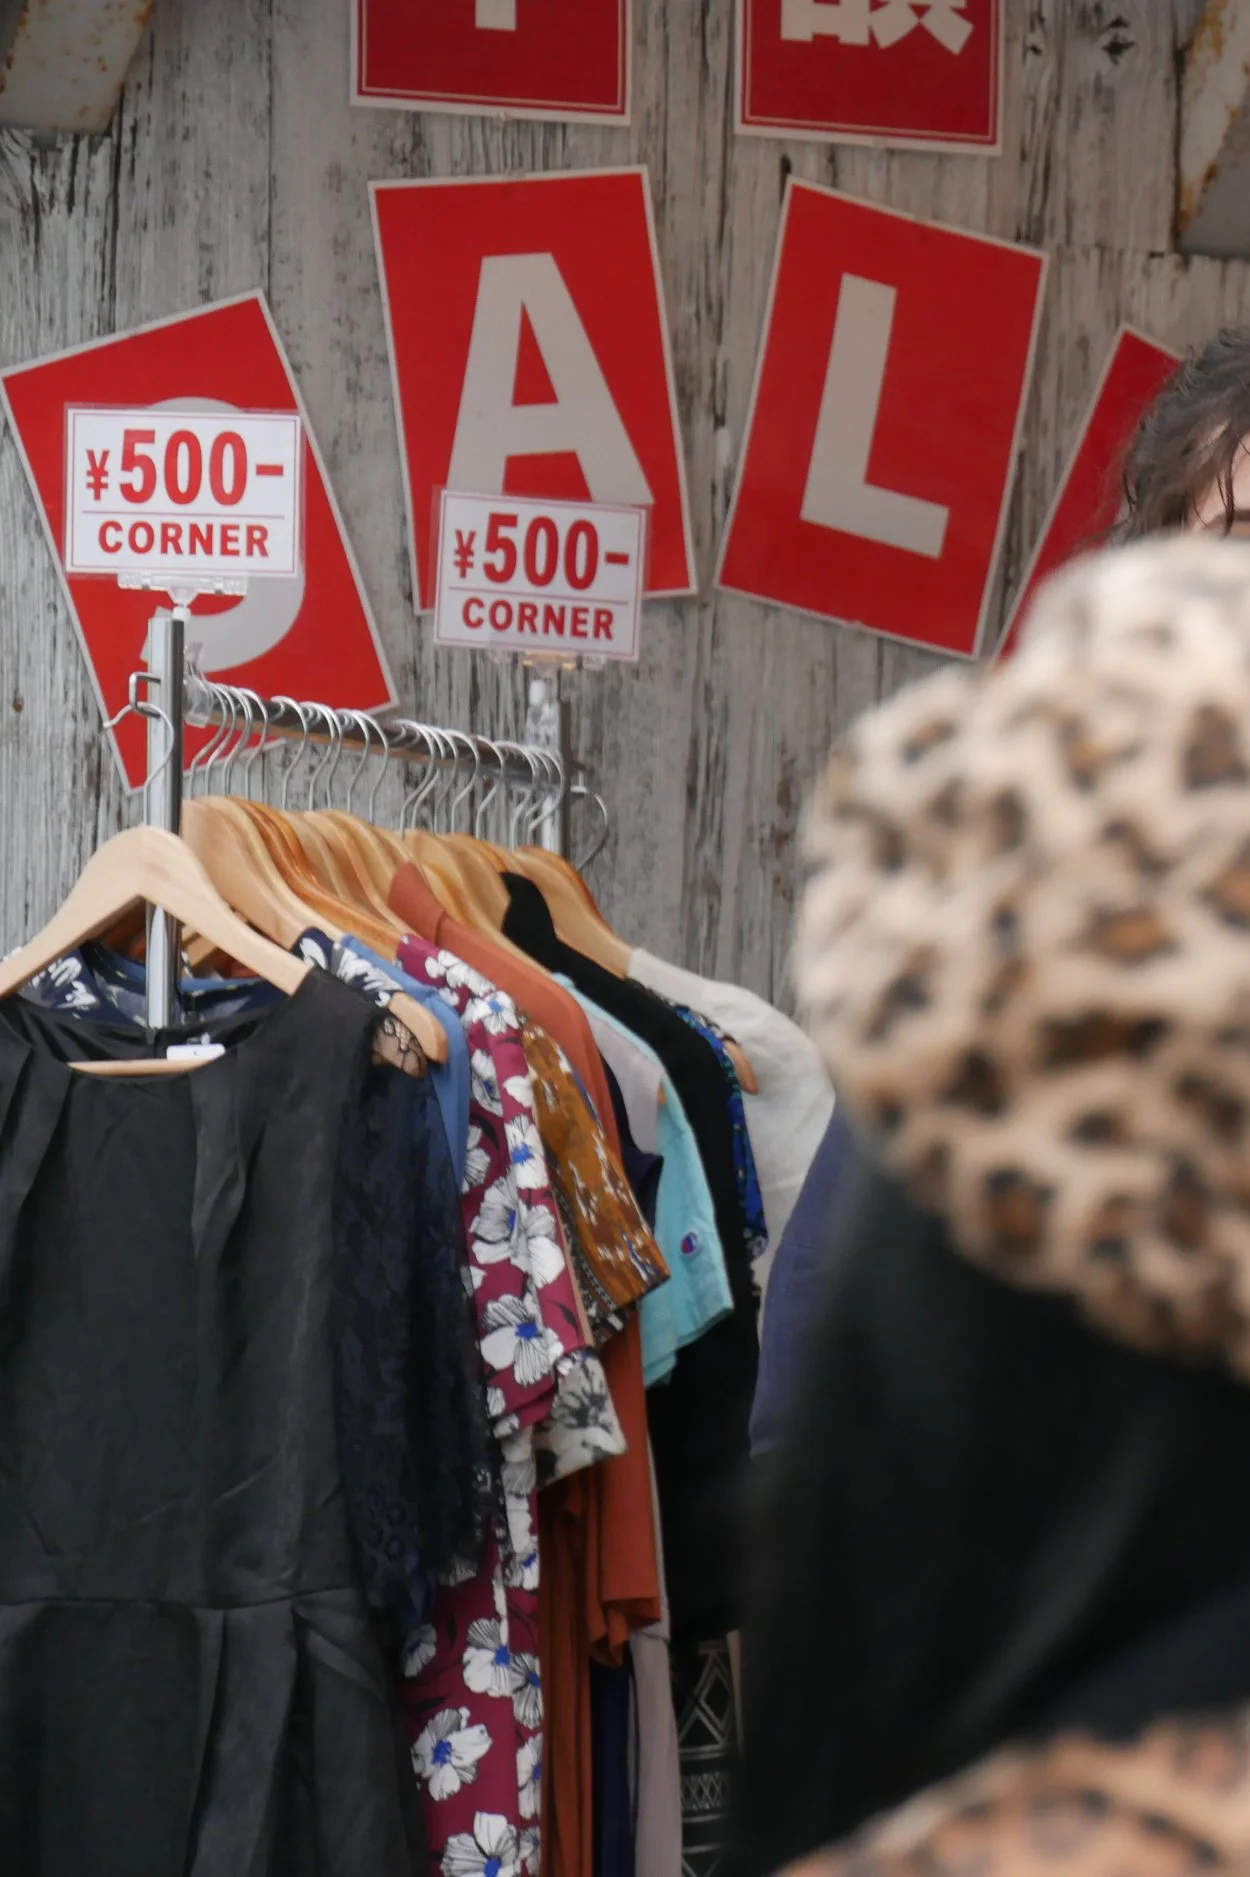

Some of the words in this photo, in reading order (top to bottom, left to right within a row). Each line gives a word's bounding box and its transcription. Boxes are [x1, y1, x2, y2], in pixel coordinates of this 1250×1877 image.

[86, 428, 284, 506] ¥500-
[98, 520, 269, 557] CORNER
[453, 511, 630, 590] ¥500-
[462, 597, 614, 640] CORNER
